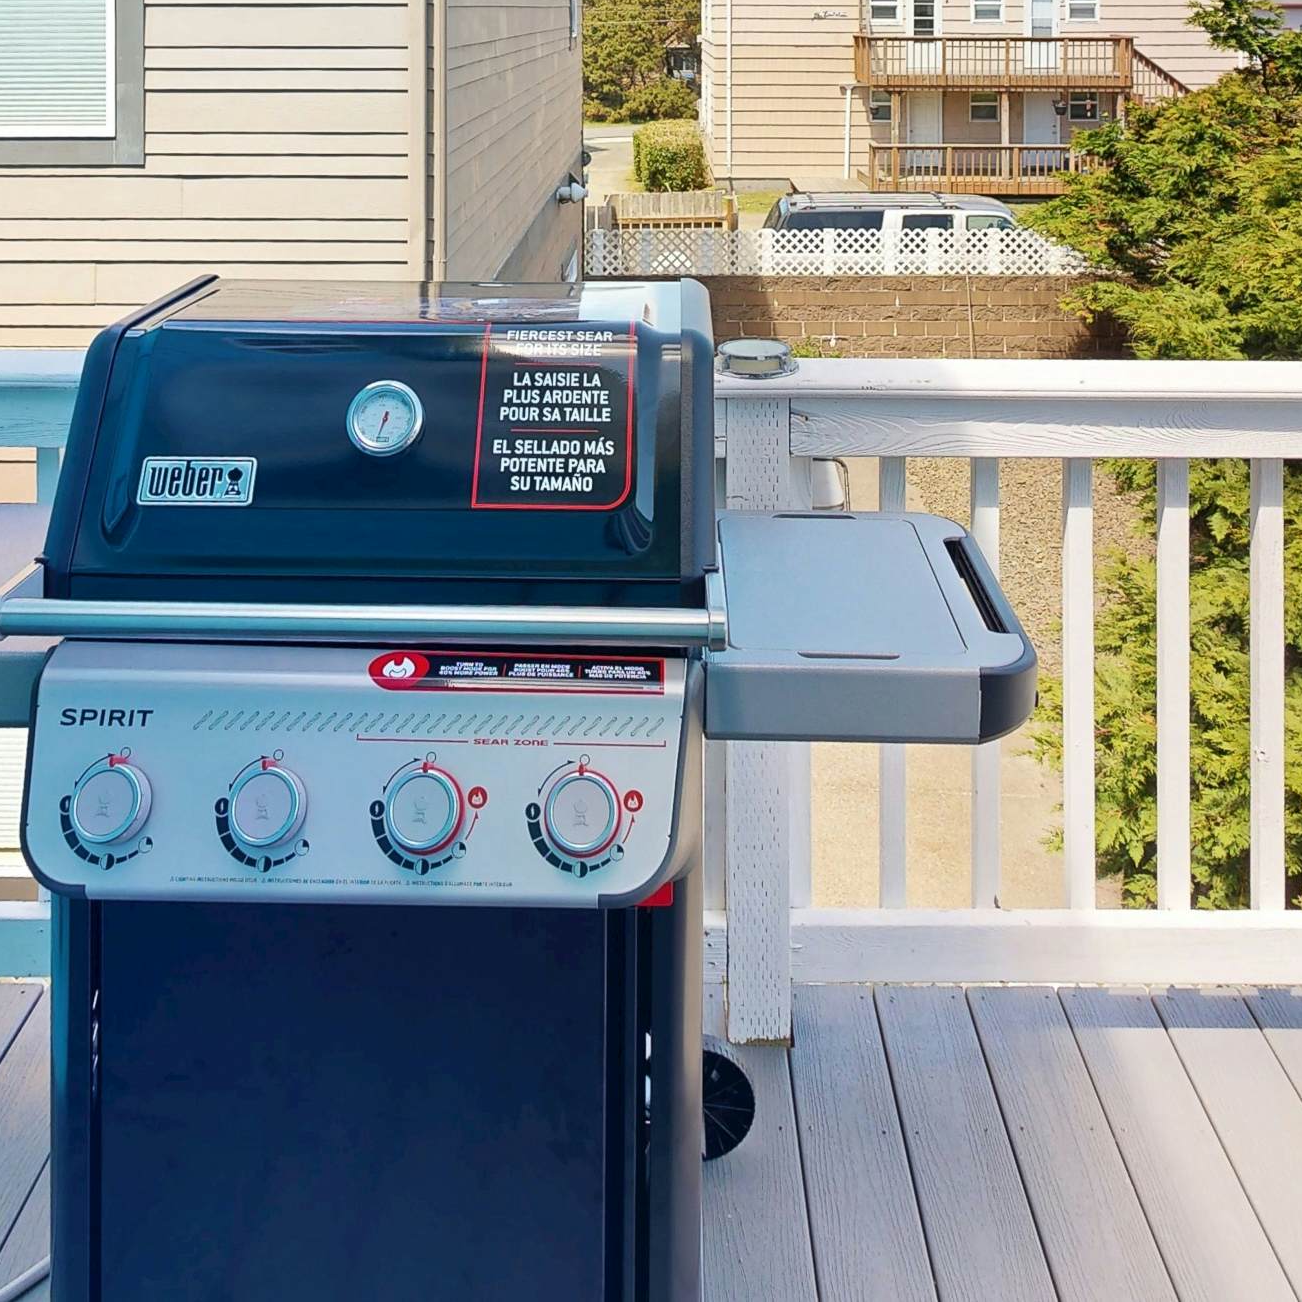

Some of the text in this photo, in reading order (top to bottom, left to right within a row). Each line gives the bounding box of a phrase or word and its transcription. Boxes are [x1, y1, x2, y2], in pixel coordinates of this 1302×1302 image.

[506, 330, 613, 342] FIERCEST SEAR
[570, 343, 603, 357] SIZE
[513, 372, 602, 388] LA SAISIE LA
[503, 389, 609, 404] PLUS ARDENTE
[499, 407, 611, 422] POUR SA TAILLE
[492, 437, 615, 456] EL SELLADO MÁS
[500, 457, 606, 474] POTENTE PARA
[148, 460, 224, 497] weber
[510, 473, 593, 492] SU TAMAÑO
[59, 707, 154, 727] SPIRIT
[473, 738, 509, 746] SEAR
